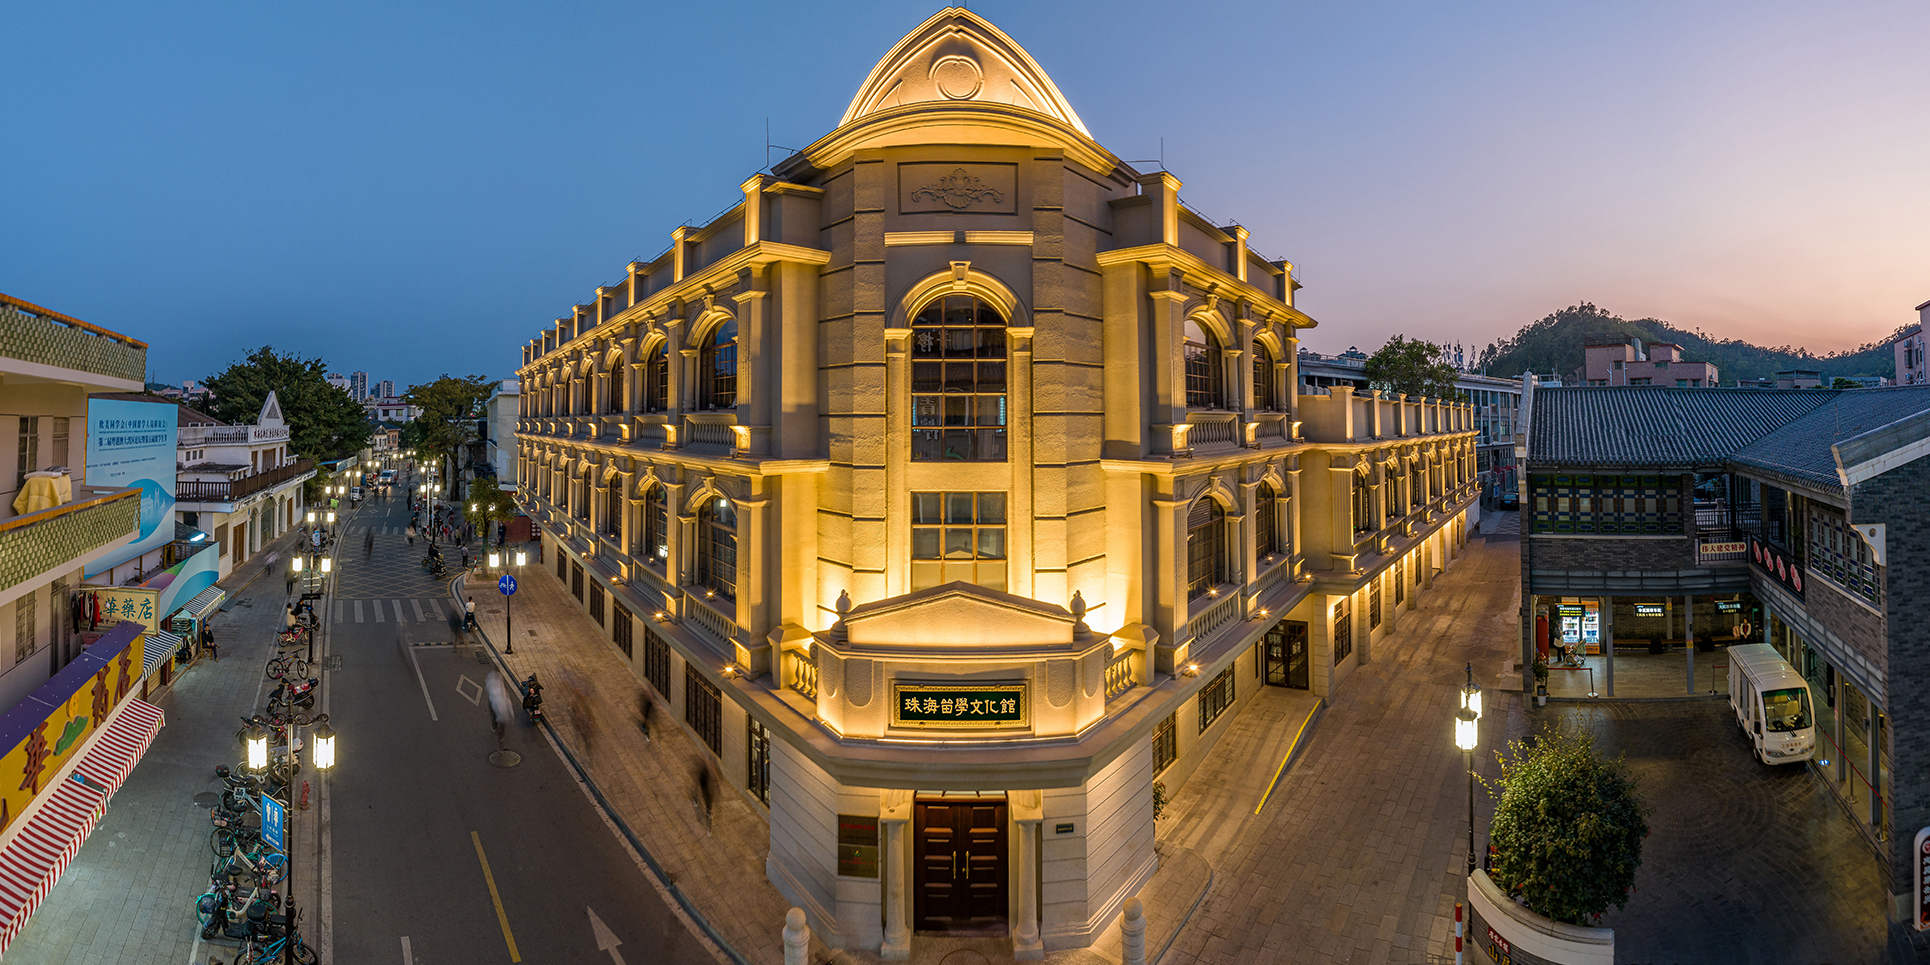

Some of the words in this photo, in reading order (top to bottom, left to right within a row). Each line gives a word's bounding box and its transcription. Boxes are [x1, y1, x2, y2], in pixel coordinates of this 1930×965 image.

[1701, 543, 1746, 553] 伟大建党精神
[97, 596, 153, 620] 華藥店
